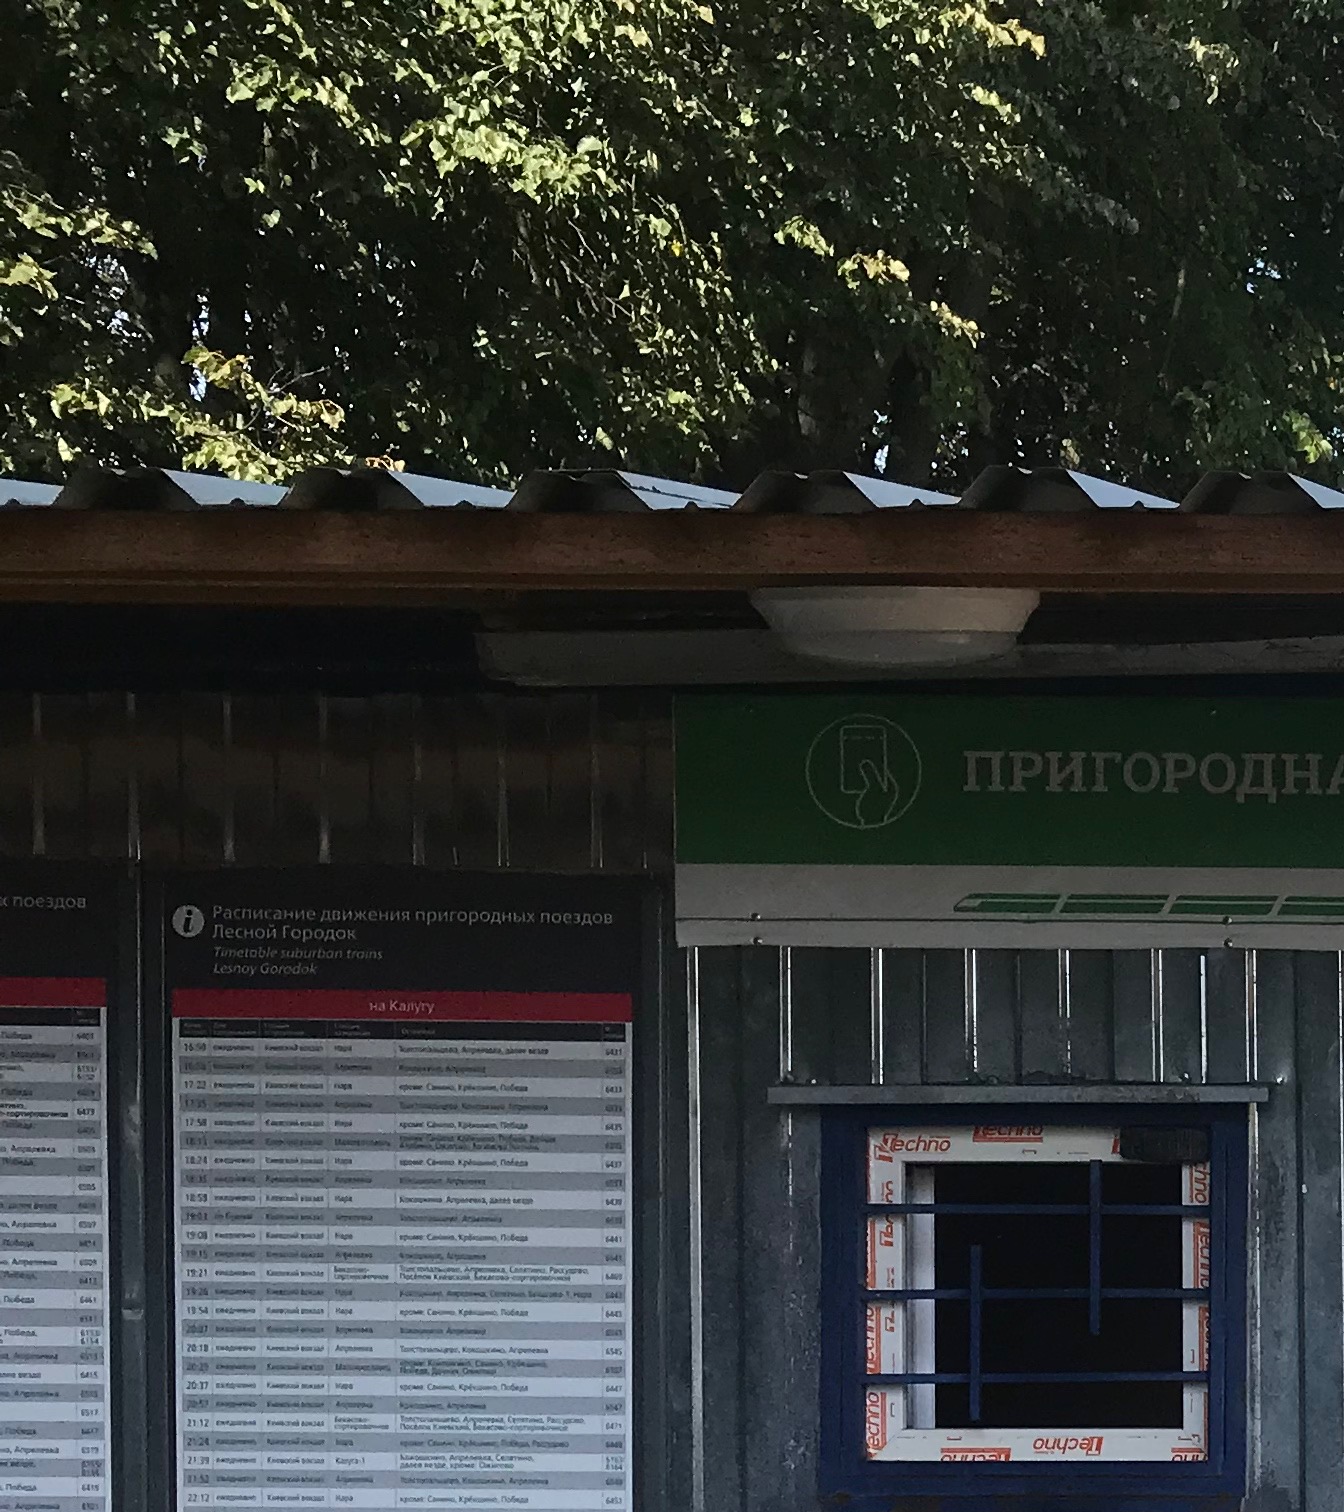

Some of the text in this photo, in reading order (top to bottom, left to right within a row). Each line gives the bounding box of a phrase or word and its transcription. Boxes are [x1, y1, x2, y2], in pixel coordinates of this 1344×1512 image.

[13, 896, 87, 910] поездов
[213, 905, 613, 926] Расписание движения пригородных поездов
[212, 924, 357, 942] Лесной Городок
[214, 946, 383, 960] Timetable suburban trains
[213, 962, 318, 976] Lesnoy Gorodok
[369, 999, 435, 1015] на Калугу
[883, 1133, 951, 1153] Techno
[1032, 1436, 1104, 1457] Techno
